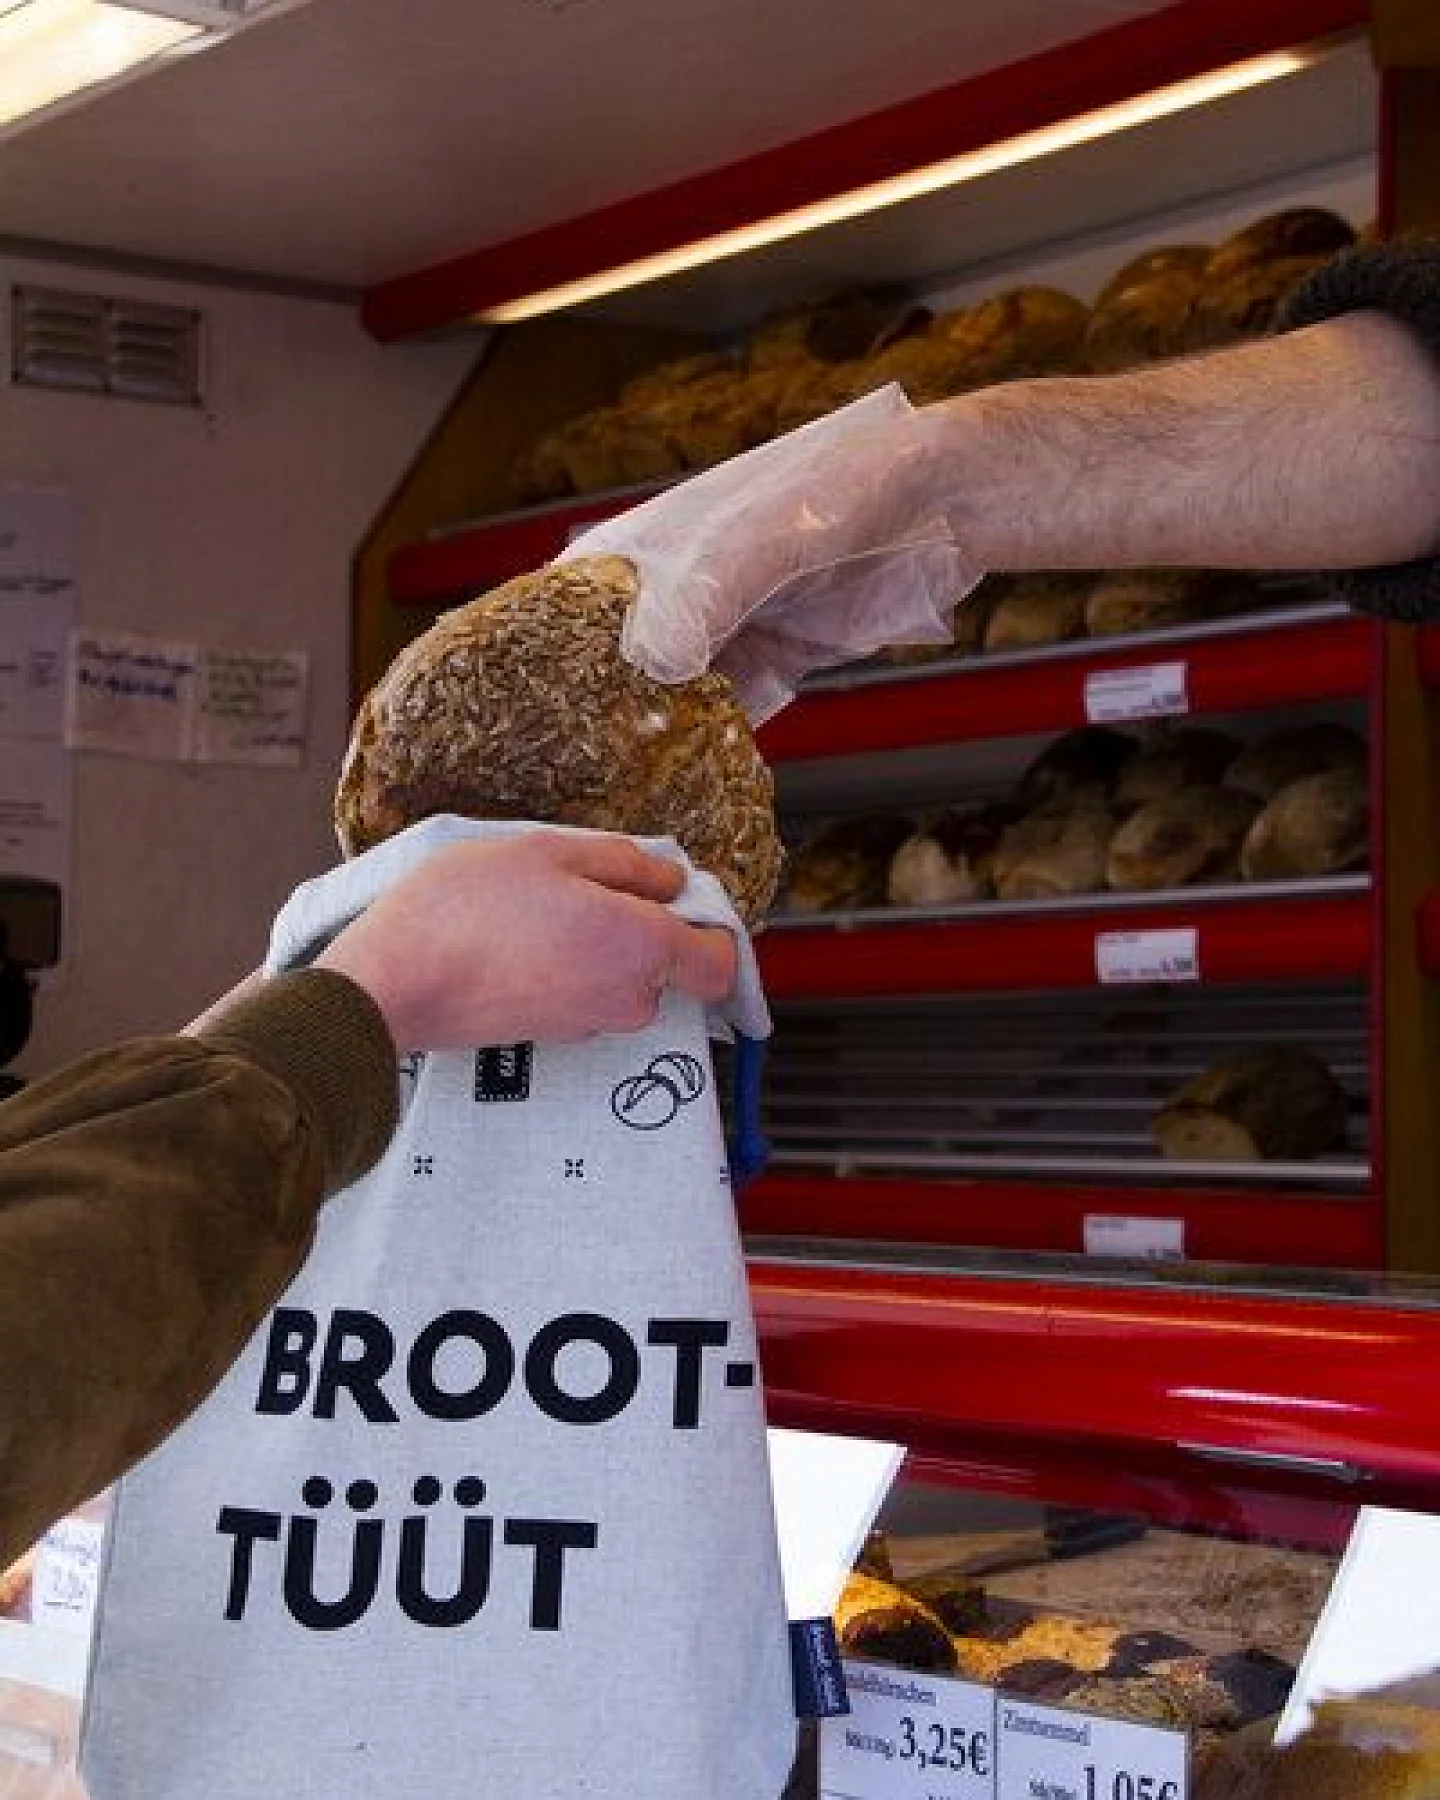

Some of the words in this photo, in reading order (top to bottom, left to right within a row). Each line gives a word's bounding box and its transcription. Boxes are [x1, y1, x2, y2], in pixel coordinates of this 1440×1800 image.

[255, 1308, 754, 1430] BROOT-
[216, 1476, 599, 1632] TÜÜT
[898, 1716, 989, 1776] 3,25€
